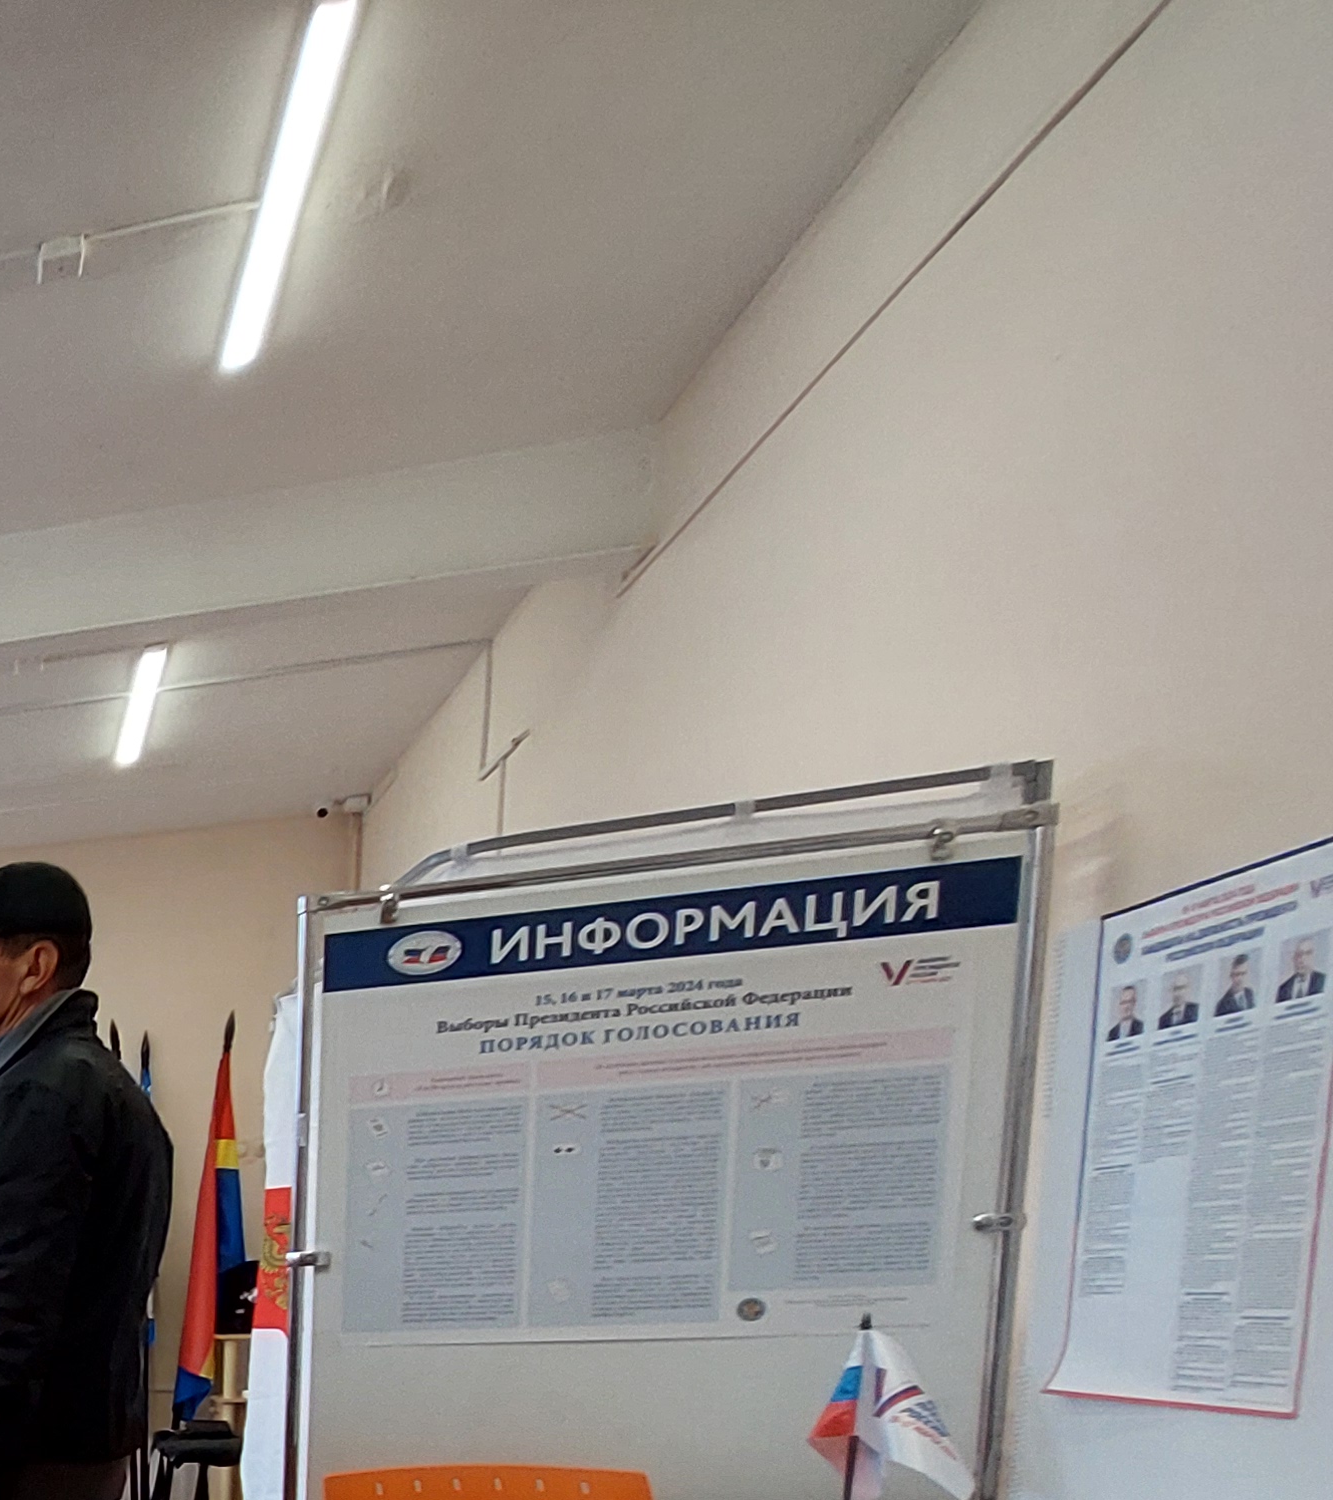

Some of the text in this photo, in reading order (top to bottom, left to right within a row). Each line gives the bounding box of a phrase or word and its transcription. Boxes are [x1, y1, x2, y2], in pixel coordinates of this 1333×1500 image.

[489, 880, 941, 965] ИНФОРМАЦИЯ
[436, 985, 853, 1035] Выборы Президента Российской Федерации
[560, 992, 577, 1004] 16
[596, 988, 612, 1001] 17
[617, 984, 663, 1001] марта
[667, 979, 704, 993] 2024
[707, 978, 743, 991] года
[478, 1011, 801, 1054] ПОРЯДОК ГОЛОСОВАНИЯ
